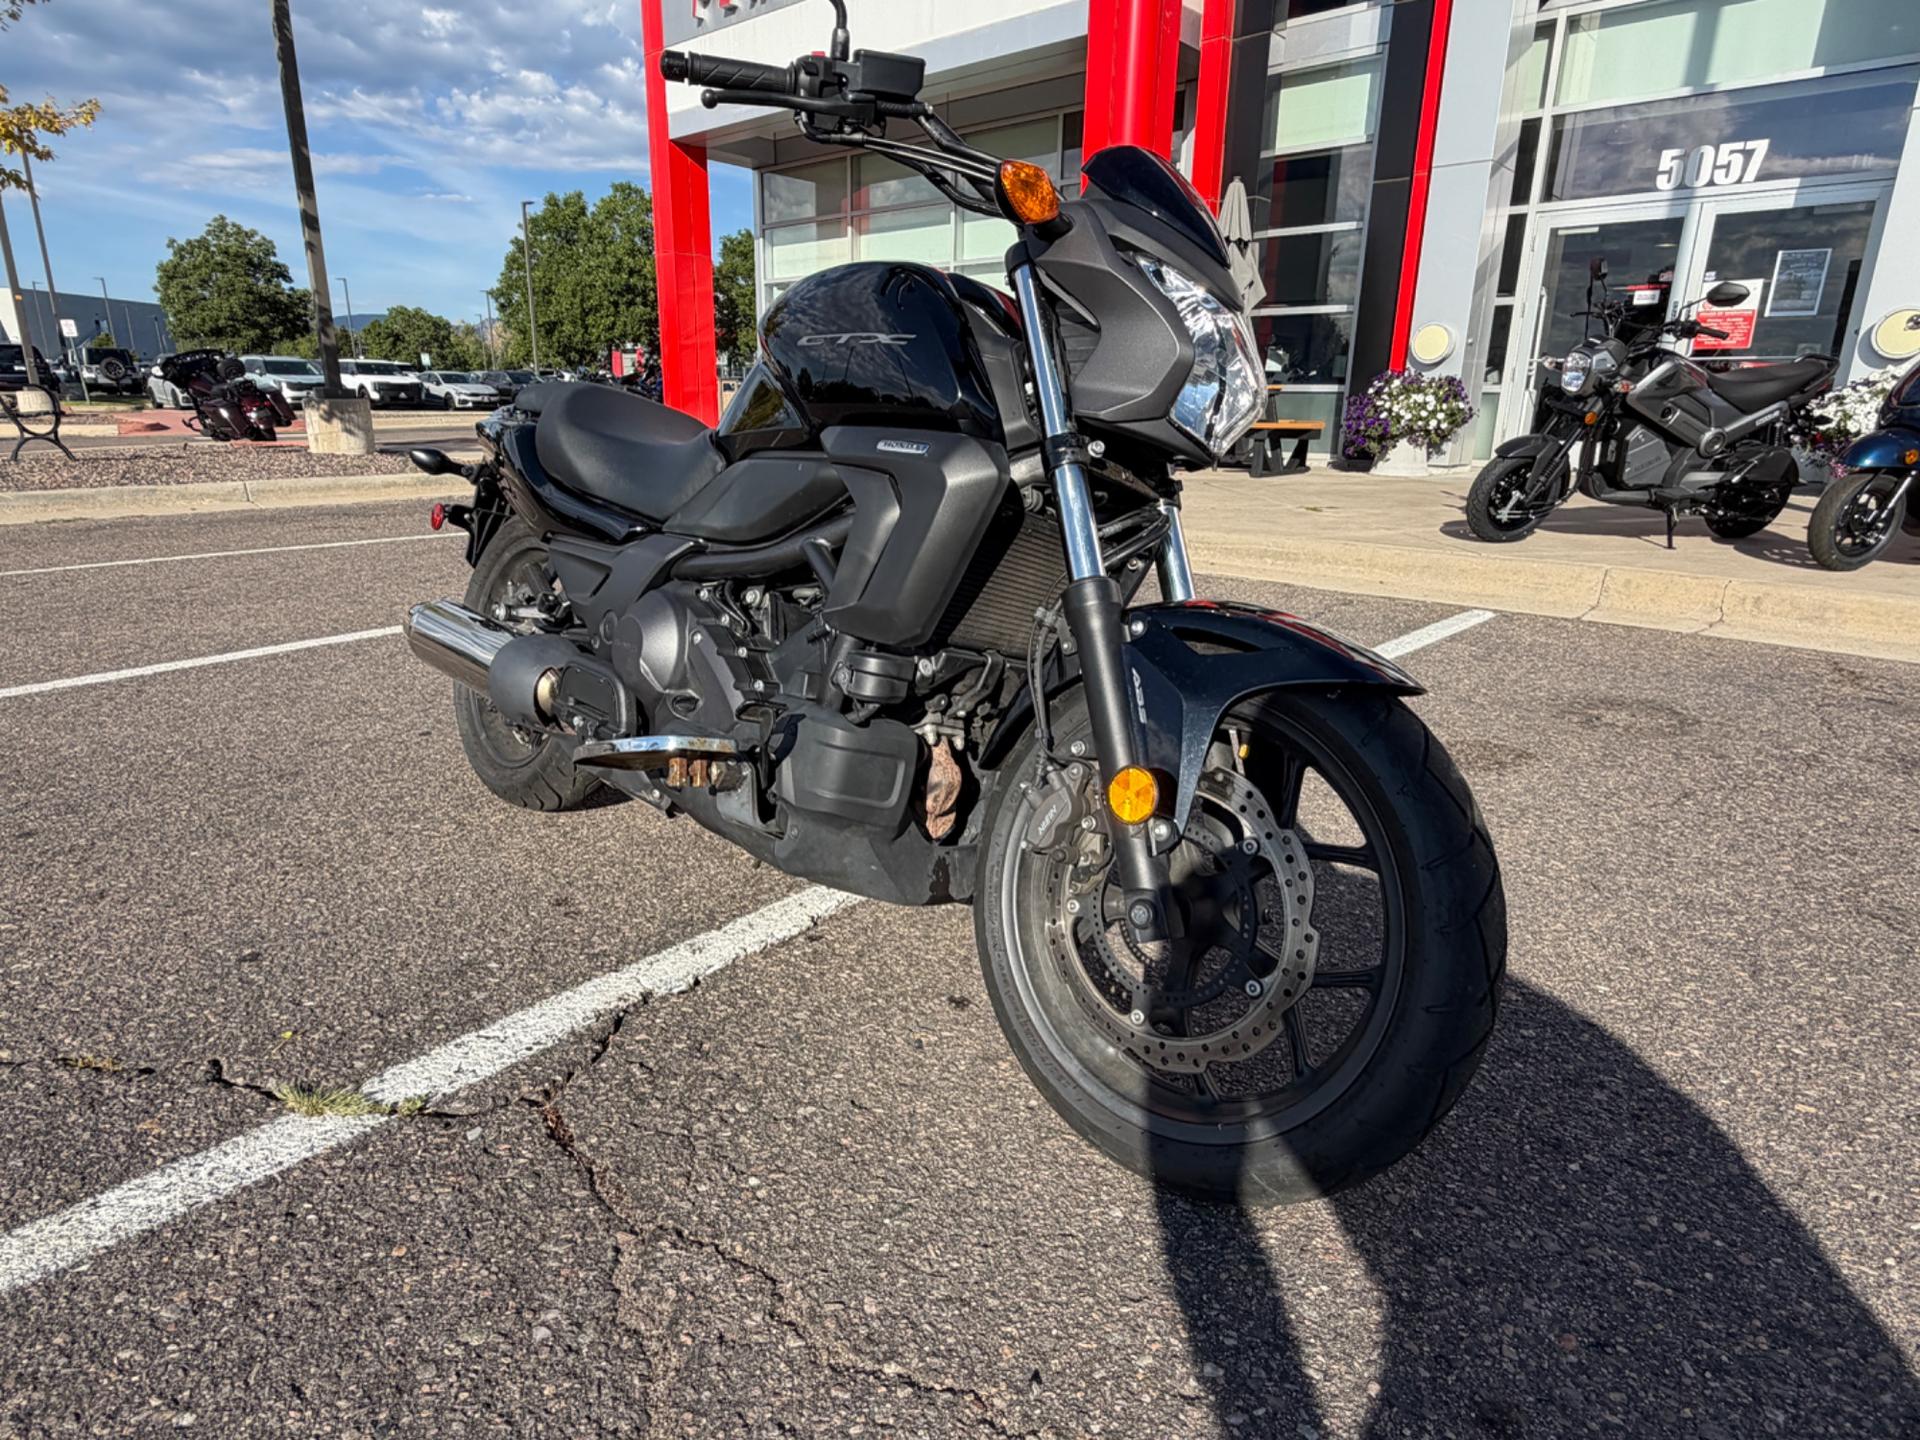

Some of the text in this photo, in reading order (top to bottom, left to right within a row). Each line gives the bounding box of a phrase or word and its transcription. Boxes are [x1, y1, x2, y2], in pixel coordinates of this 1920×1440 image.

[1655, 138, 1770, 191] 5057
[797, 332, 917, 346] CTX
[1131, 666, 1148, 724] ABS
